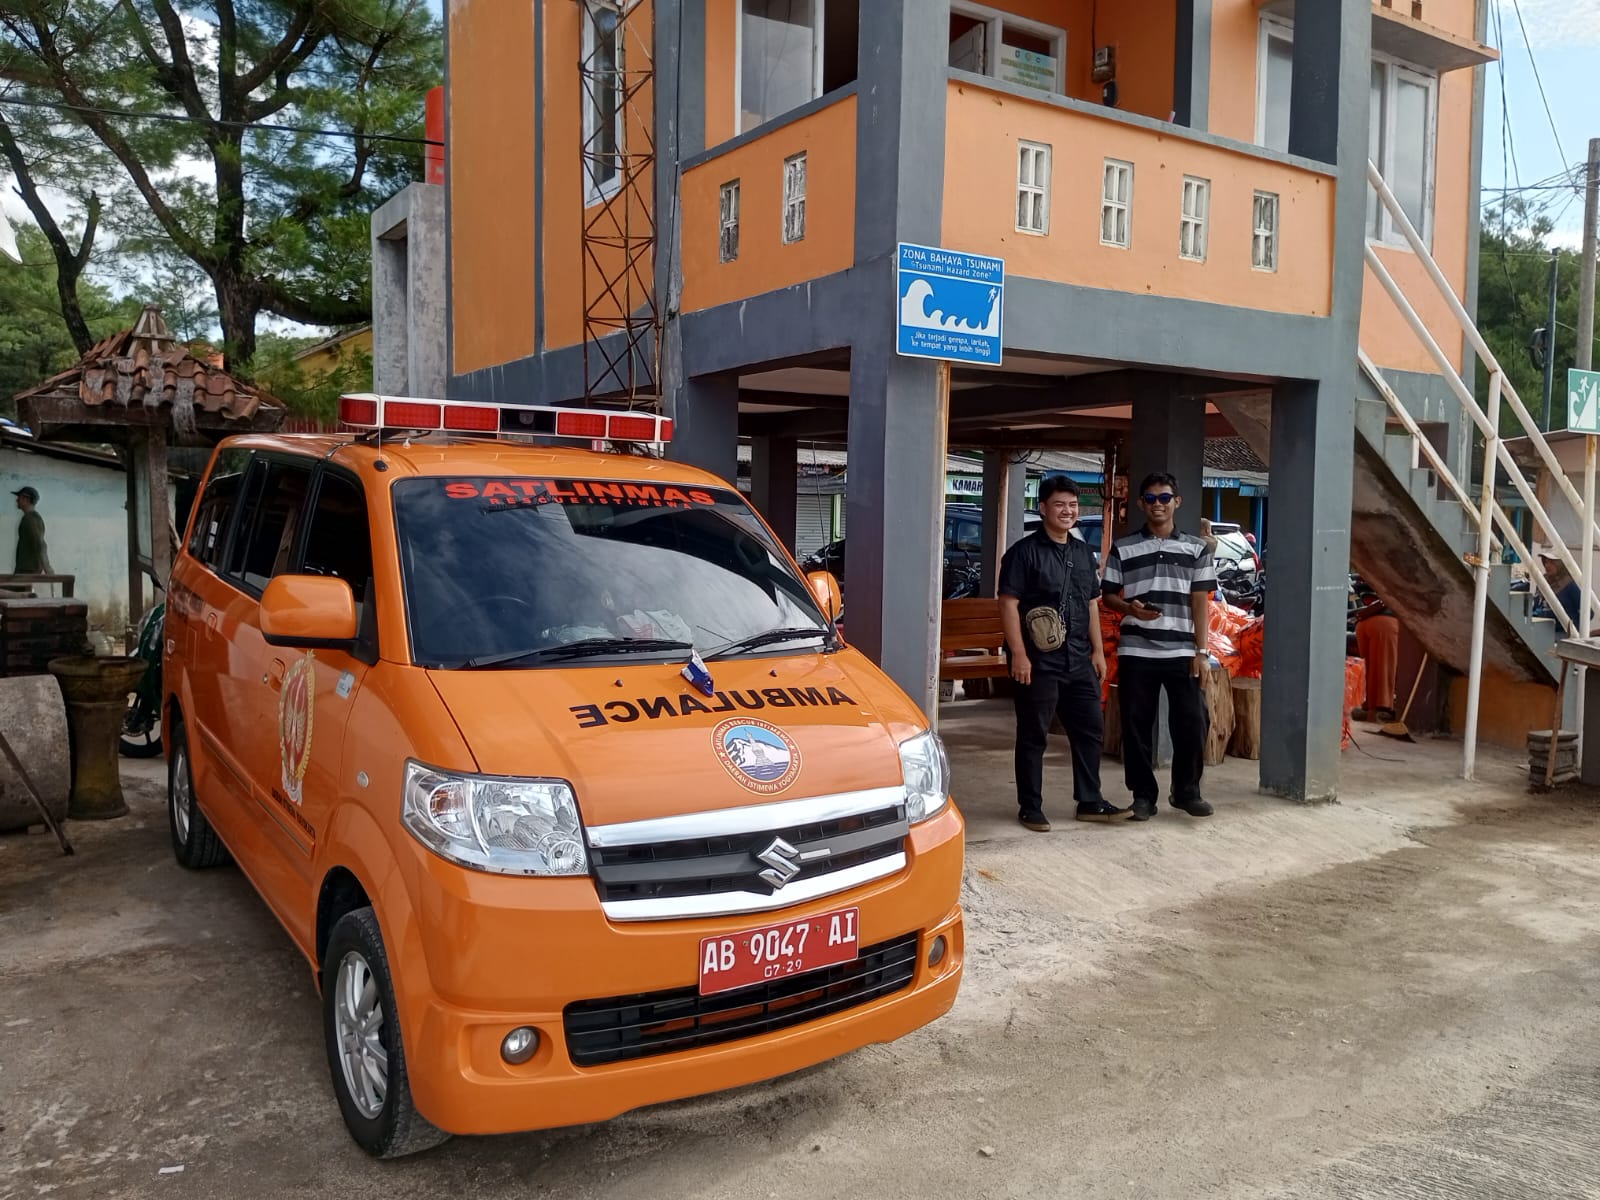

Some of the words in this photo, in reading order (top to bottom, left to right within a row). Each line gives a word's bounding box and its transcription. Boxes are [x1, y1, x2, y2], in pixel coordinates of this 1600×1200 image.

[903, 249, 927, 261] ZONA
[930, 252, 962, 266] BAHAYA
[966, 258, 1001, 272] TSUNAMI
[946, 265, 970, 276] Hazard
[943, 344, 958, 352] yang
[445, 480, 717, 506] SATLINMAS
[489, 496, 580, 505] RESCUE
[724, 760, 747, 784] DAERAH
[747, 782, 778, 791] ISTIMEWA
[703, 939, 736, 975] AB
[750, 923, 810, 965] 9047
[828, 912, 856, 947] AI
